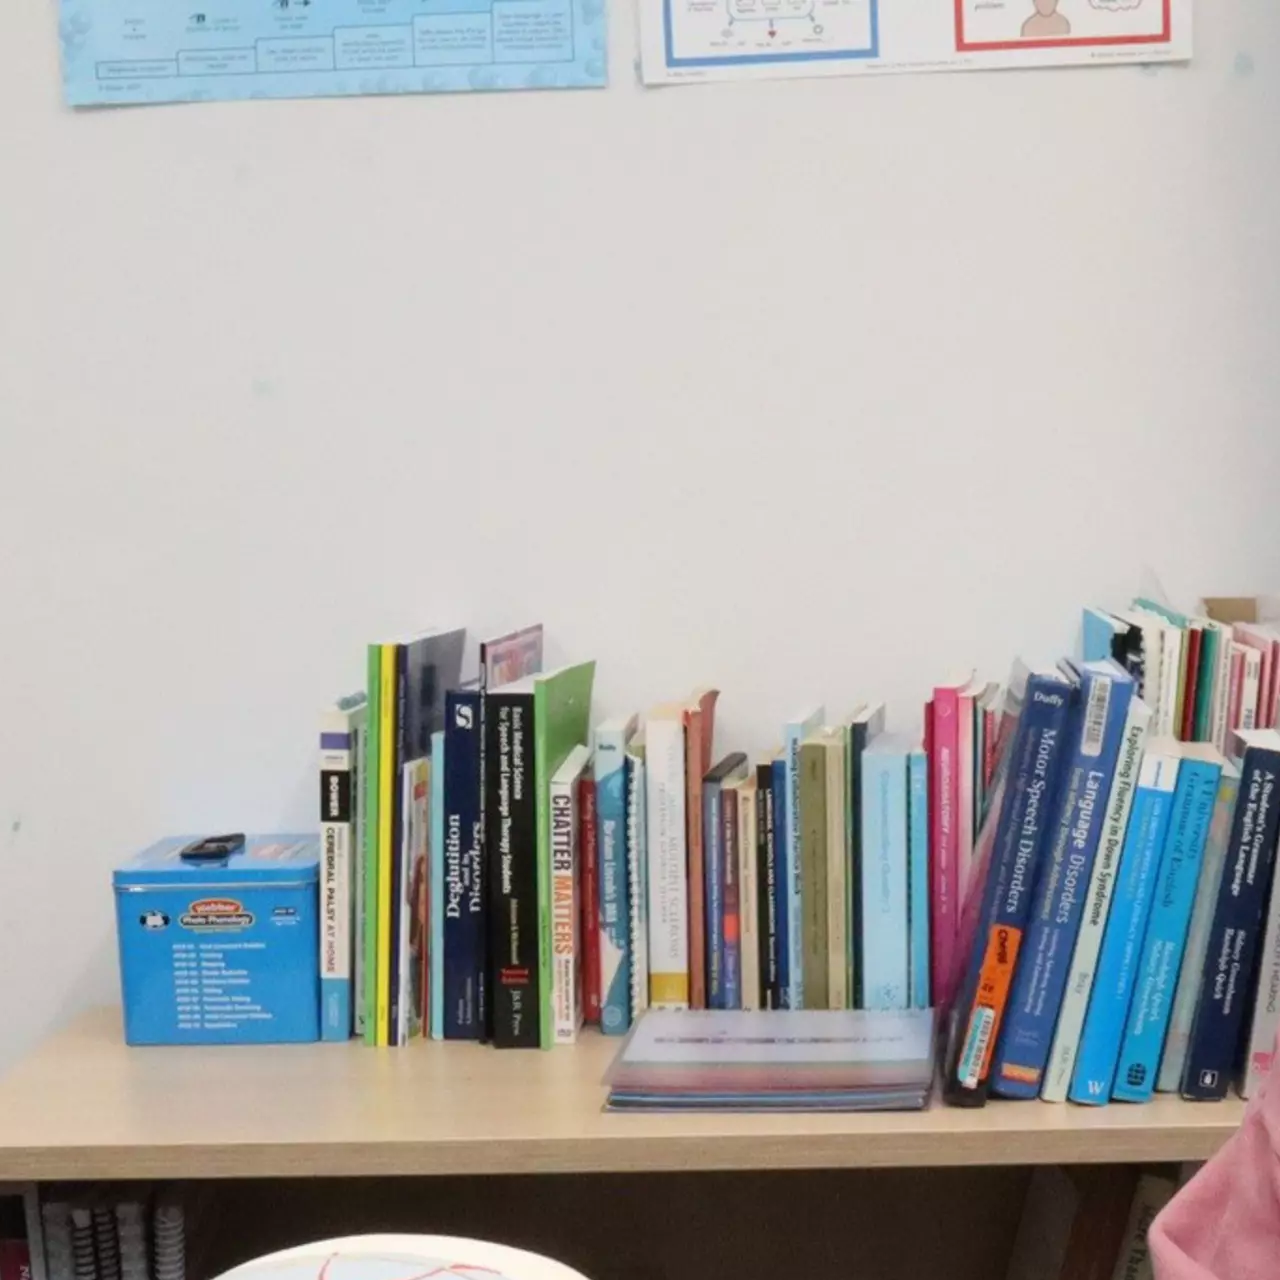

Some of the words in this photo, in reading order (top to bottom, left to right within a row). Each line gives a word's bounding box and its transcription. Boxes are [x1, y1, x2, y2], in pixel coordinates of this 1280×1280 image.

[499, 706, 510, 719] for
[512, 706, 523, 729] Basic
[1034, 691, 1064, 708] Duffy
[498, 720, 510, 754] Speech
[513, 731, 523, 766] Medical
[789, 737, 798, 772] Making
[1034, 727, 1057, 776] Motor
[1118, 724, 1143, 779] Exploring
[499, 755, 510, 772] and
[513, 767, 523, 800] Science
[1251, 768, 1262, 781] of
[1264, 771, 1274, 780] A
[329, 775, 340, 817] BOWER
[498, 773, 510, 816] Language
[940, 746, 950, 833] NEUROANATOMY
[1016, 777, 1046, 836] Speech
[1068, 769, 1104, 850] Language
[1109, 779, 1131, 823] Fluency
[1248, 782, 1259, 800] the
[1254, 781, 1272, 831] Student's
[499, 817, 512, 853] Therapy
[552, 795, 572, 871] CHATTER
[1109, 824, 1121, 837] in
[1238, 801, 1257, 843] English
[325, 827, 335, 883] CEREBRAL
[444, 814, 464, 918] Deglutition
[468, 821, 481, 912] Disorders
[501, 854, 512, 894] Students
[792, 836, 800, 871] Practice
[1102, 838, 1119, 870] Down
[1229, 844, 1249, 897] Language
[1245, 833, 1262, 884] Grammar
[1005, 838, 1034, 914] Disorders
[1054, 852, 1085, 925] Disorders
[326, 887, 335, 920] PALSY
[553, 875, 573, 955] MATTERS
[1086, 870, 1112, 927] Syndrome
[326, 923, 334, 936] AT
[668, 897, 679, 958] SCLEROSIS
[326, 940, 334, 972] HOME
[1265, 968, 1280, 1013] HEARING
